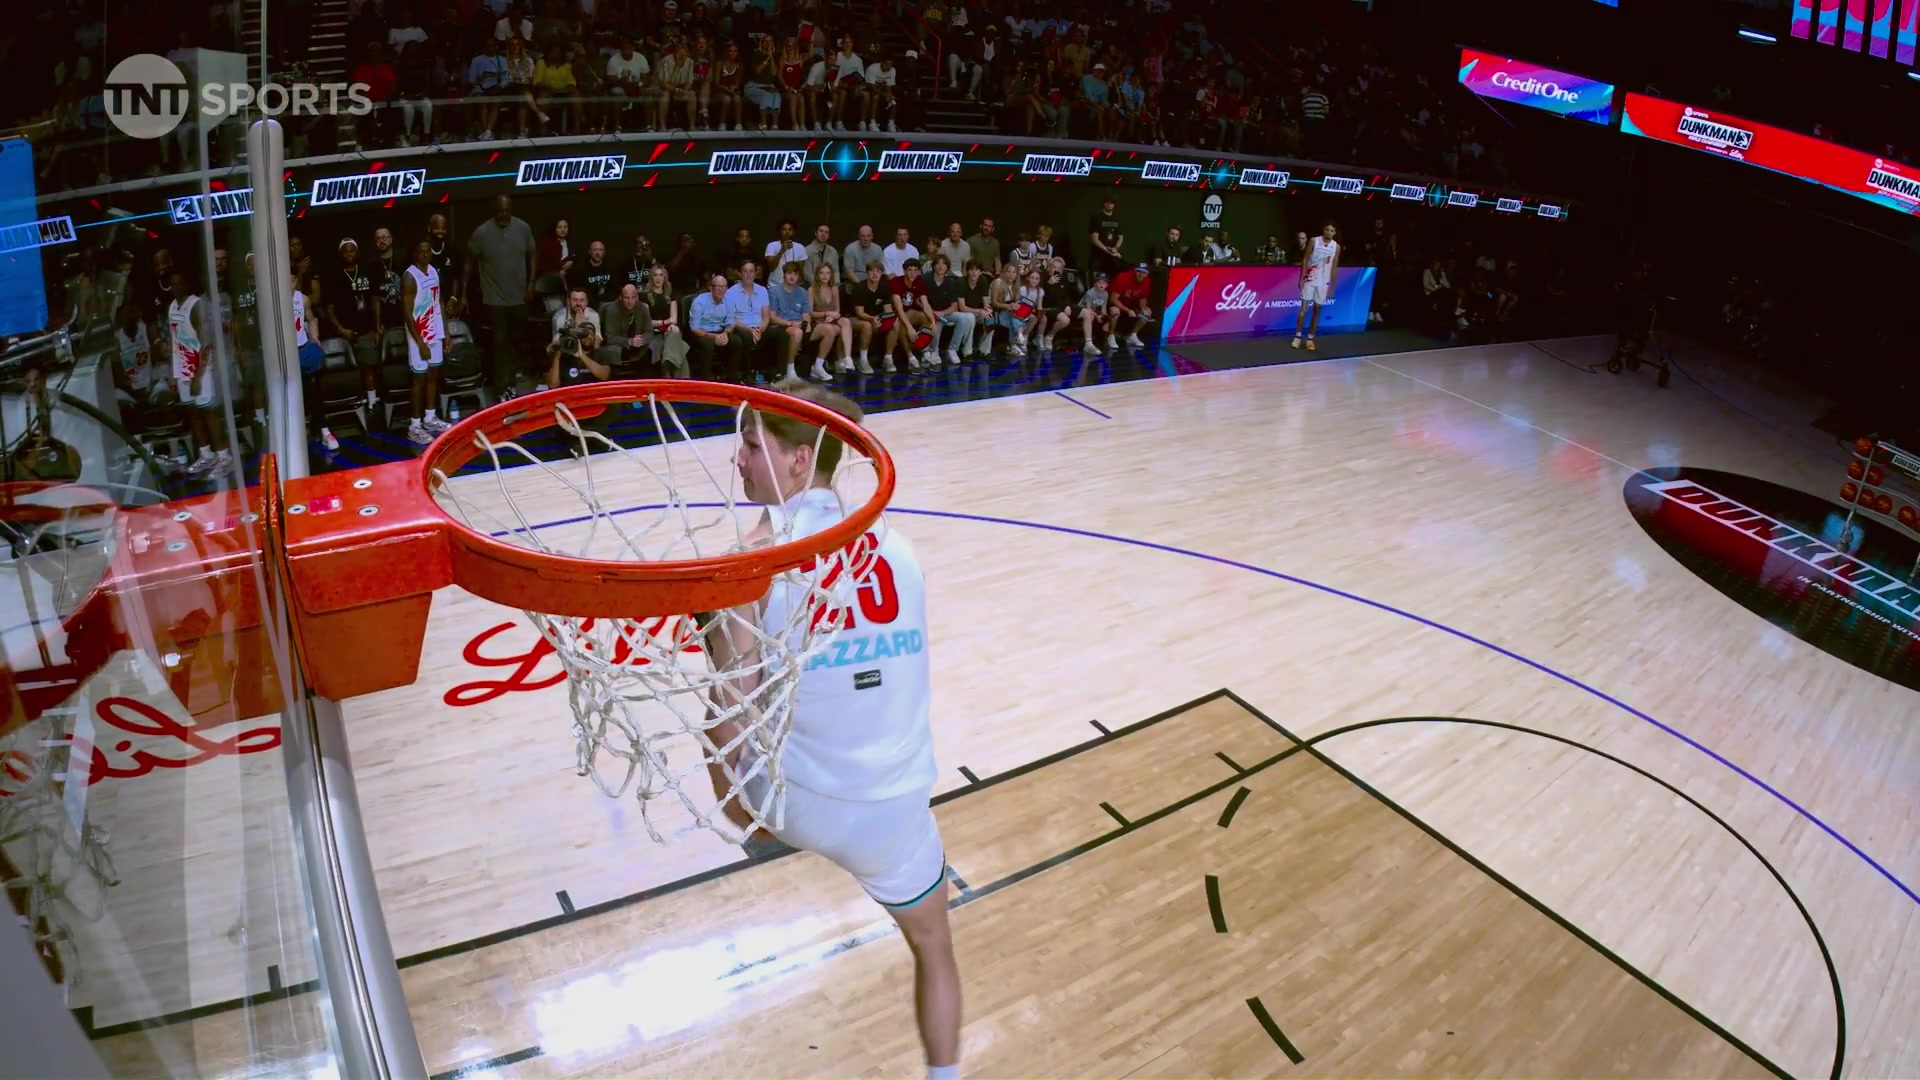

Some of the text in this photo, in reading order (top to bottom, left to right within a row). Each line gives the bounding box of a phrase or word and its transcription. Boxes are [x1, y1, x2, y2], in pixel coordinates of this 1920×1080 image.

[1492, 71, 1579, 103] CreditOne
[1680, 119, 1737, 143] DUNKMAN
[521, 159, 602, 183] DUNKMAN
[713, 153, 787, 172] DUNKMAN
[882, 153, 945, 171] DUNKMAN
[1025, 156, 1078, 173] DUNKMAN
[1143, 163, 1189, 179] DUNKMAN
[316, 174, 401, 202] DUNKMAN
[1869, 171, 1920, 199] DUNKMA
[1215, 281, 1262, 318] Lilly
[1271, 300, 1302, 308] MEDICIN
[1660, 484, 1920, 615] DUNKMA
[1797, 575, 1812, 583] IN
[1812, 583, 1891, 624] PARTNERSHIP
[803, 629, 923, 671] AZZARD
